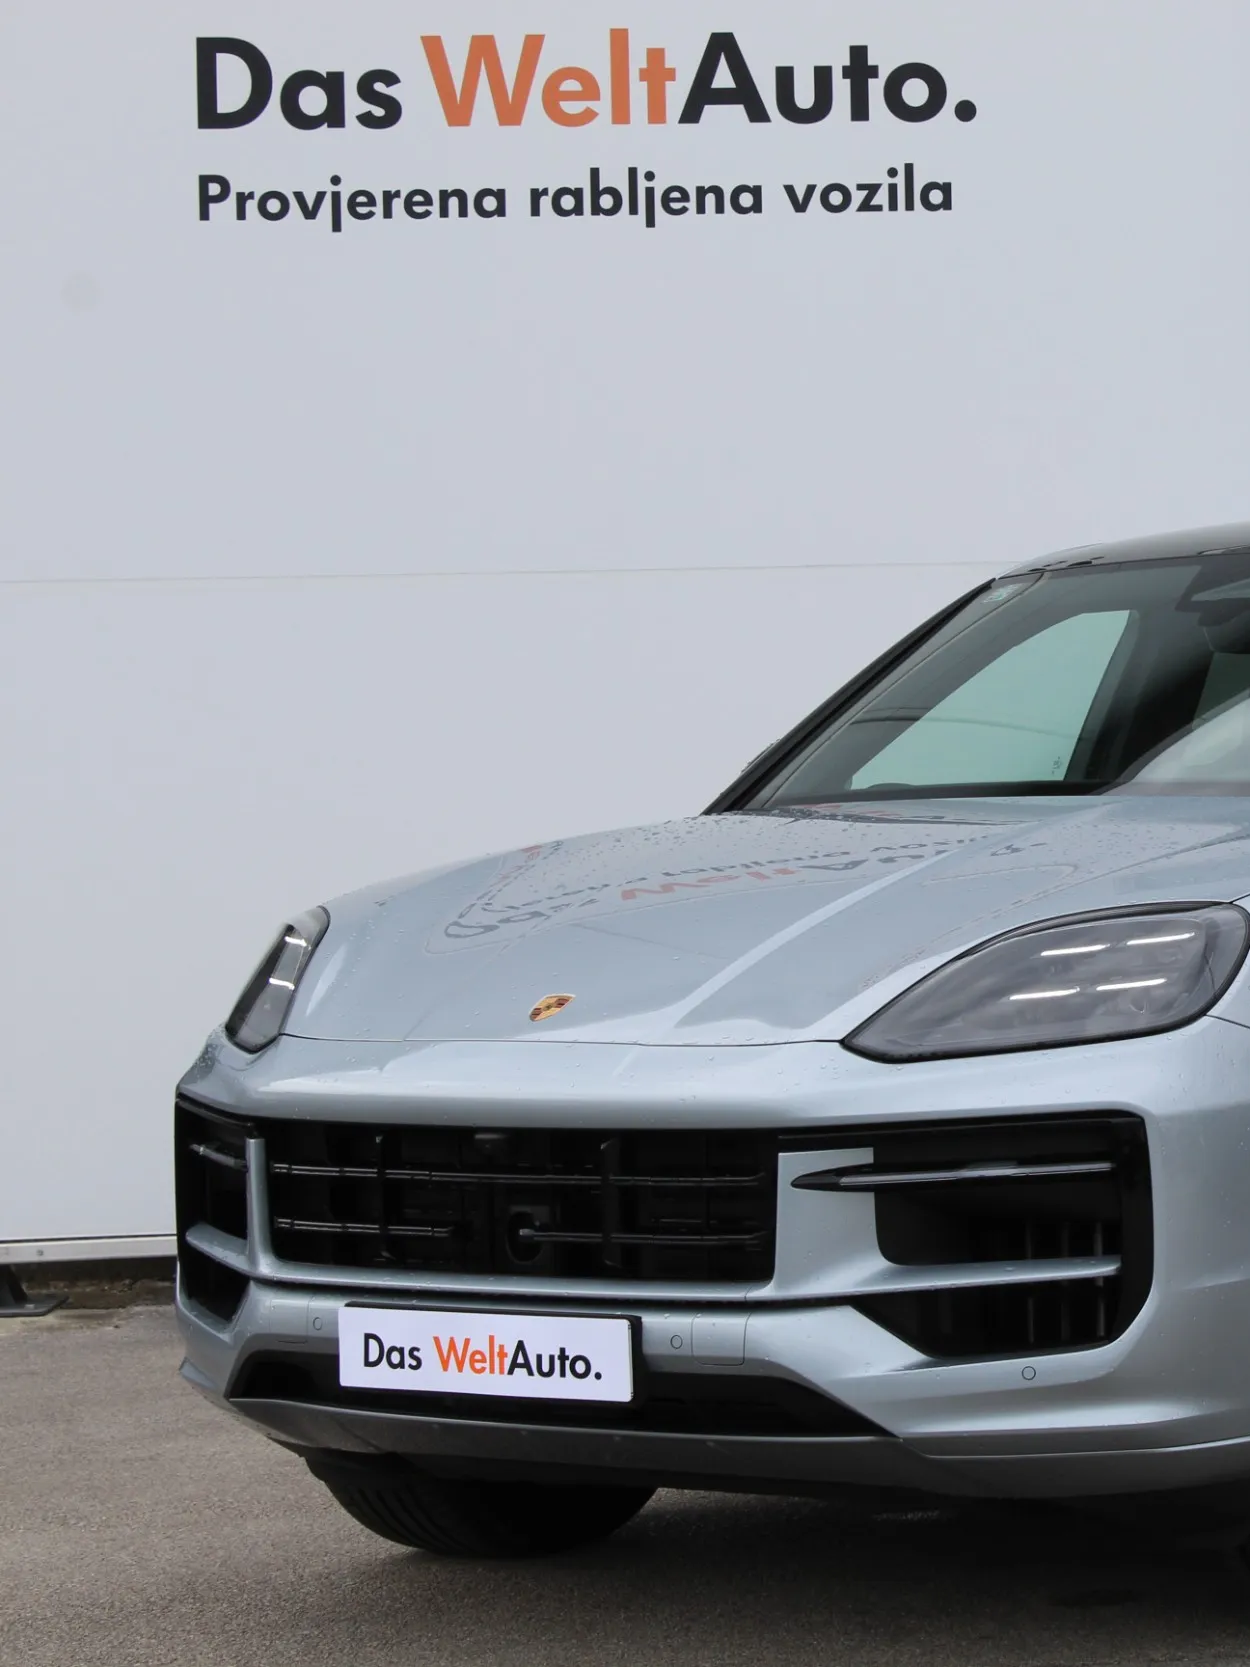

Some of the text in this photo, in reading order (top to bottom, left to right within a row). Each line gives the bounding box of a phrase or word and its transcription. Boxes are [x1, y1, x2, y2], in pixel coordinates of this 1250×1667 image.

[195, 28, 977, 131] Das WeltAuto.
[198, 162, 953, 233] Provjerena rabljena vozila
[363, 1332, 603, 1381] Das WeltAuto.
